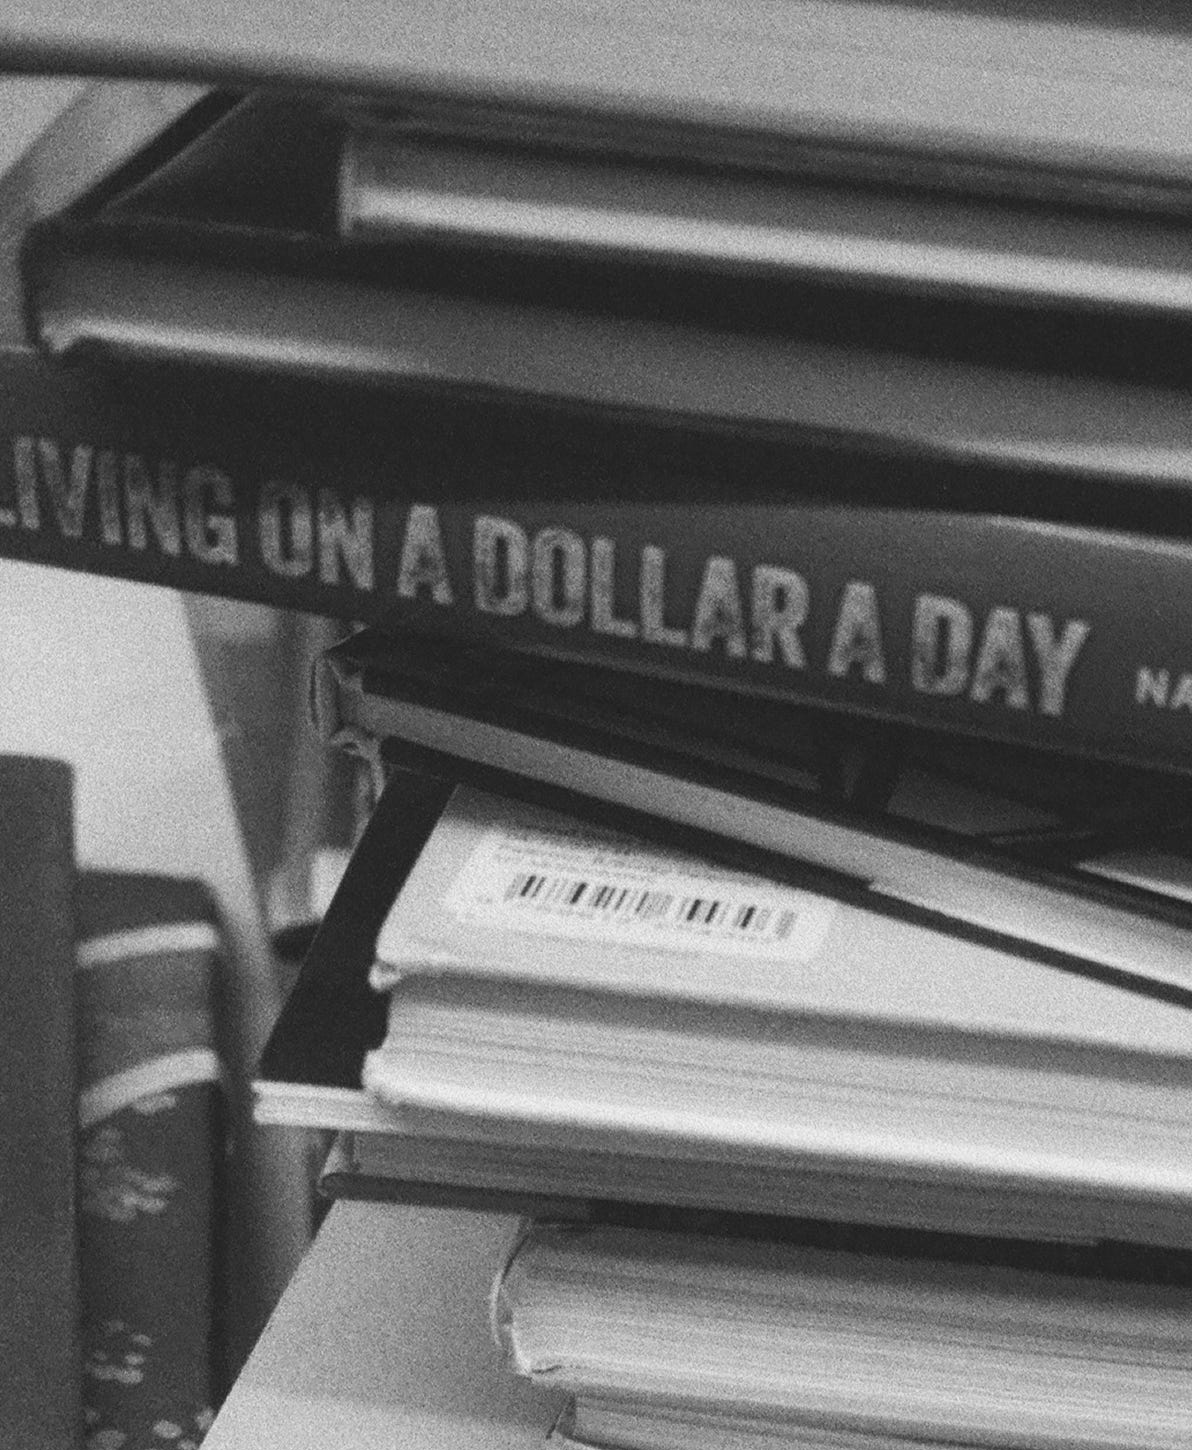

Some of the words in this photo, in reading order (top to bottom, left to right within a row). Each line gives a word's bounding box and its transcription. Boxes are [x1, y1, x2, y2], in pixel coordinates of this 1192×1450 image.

[259, 479, 375, 592] ON
[396, 502, 453, 604] A
[472, 511, 808, 668] DOLLAR
[828, 580, 887, 685] A
[910, 593, 1091, 717] DAY
